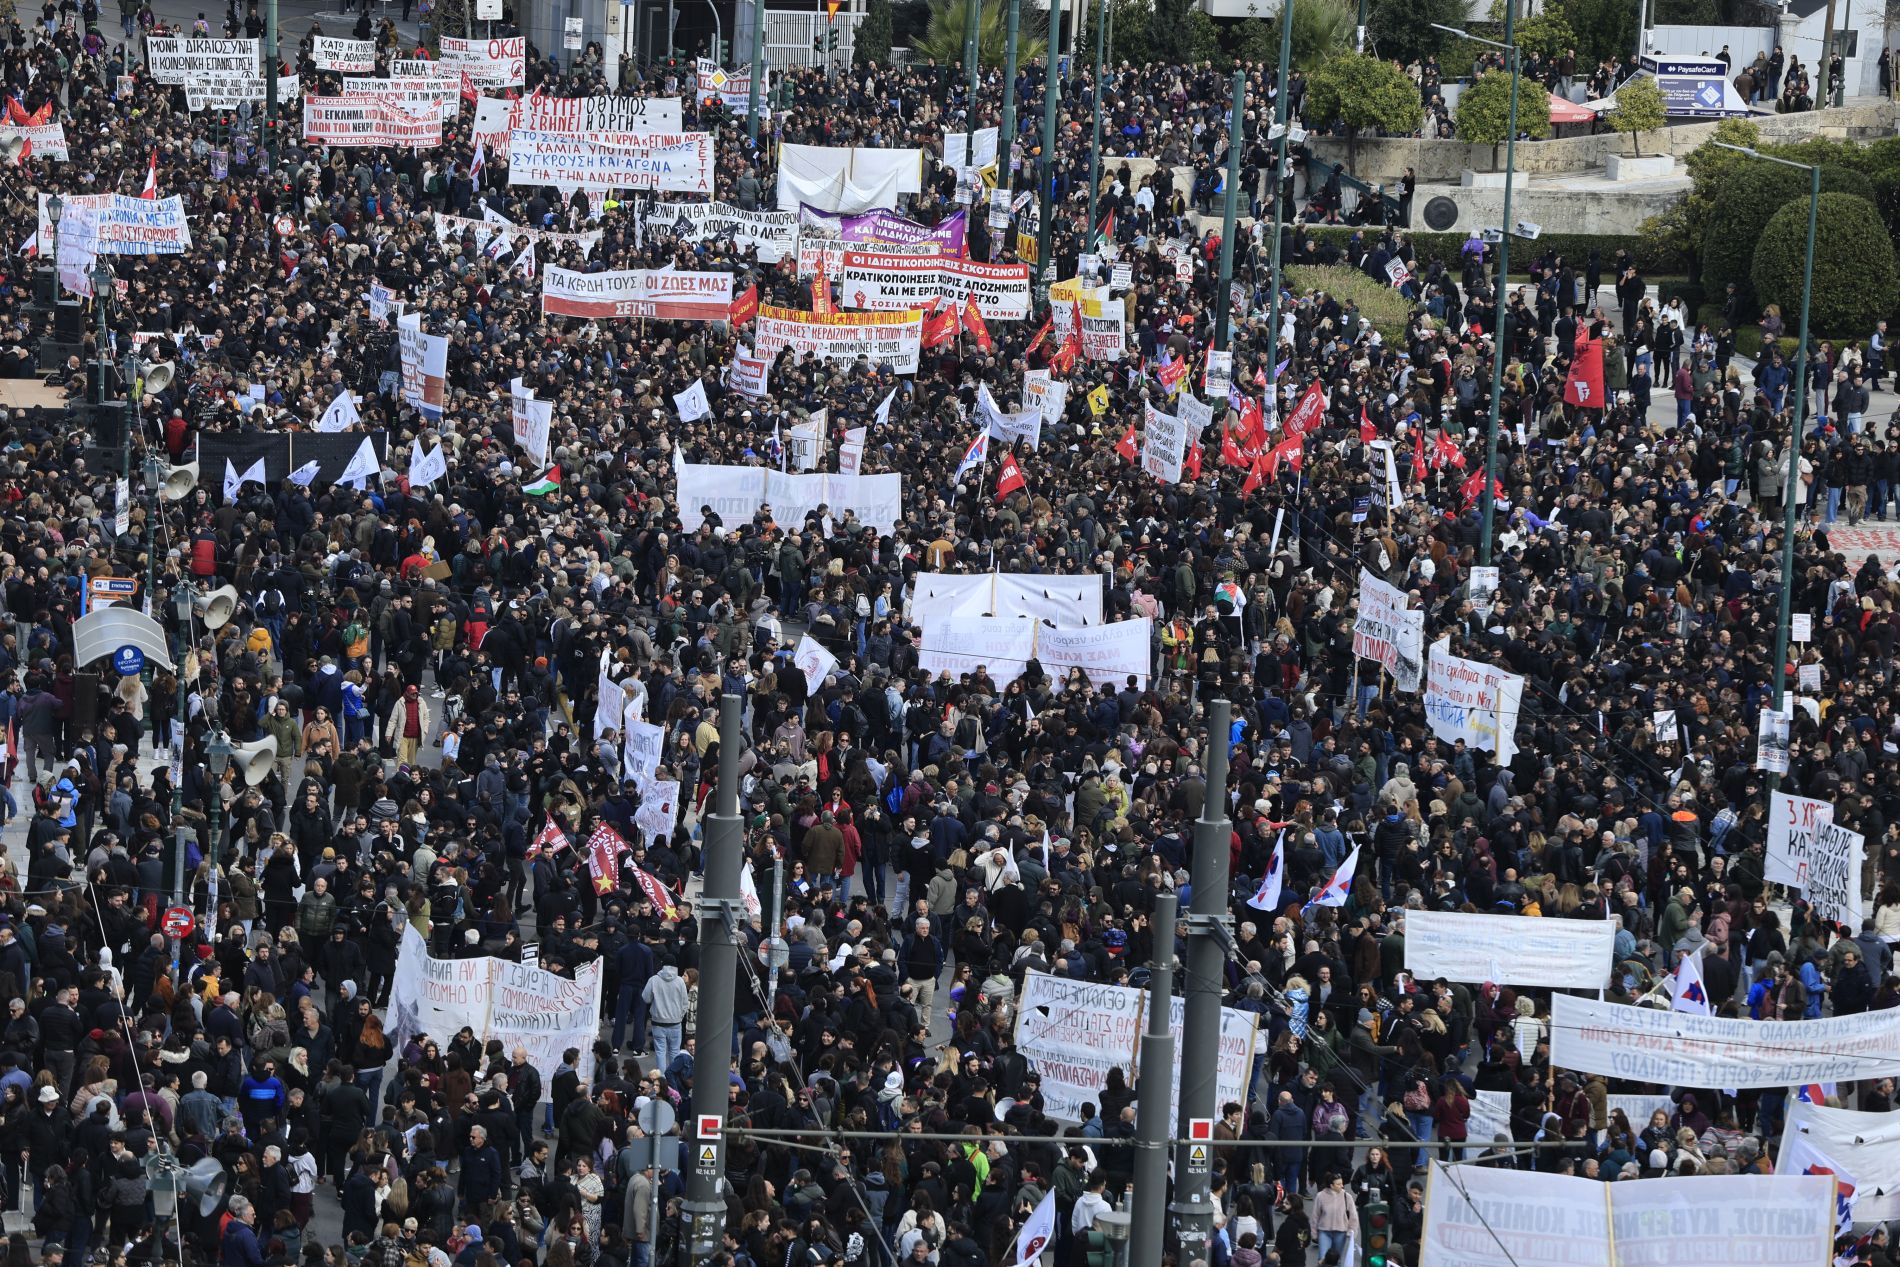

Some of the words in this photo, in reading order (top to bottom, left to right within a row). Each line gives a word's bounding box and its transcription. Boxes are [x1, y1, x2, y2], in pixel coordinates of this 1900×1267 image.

[150, 40, 178, 54] ΜΟΝΗ
[186, 40, 252, 54] ΔΙΚΑΙΟΣΥΝΗ
[320, 40, 344, 52] ΚΑΤΩ
[488, 39, 524, 59] ΟΚΔΕ
[324, 50, 340, 61] ΤΩΝ
[151, 58, 156, 69] Η
[160, 58, 204, 71] ΚΟΙΝΩΝΙΚΗ
[206, 57, 253, 71] ΕΠΑΝΑΣΤΑΣΗ
[1677, 65, 1717, 74] PaysafeCard
[346, 82, 359, 91] ΣΤΟ
[361, 82, 388, 91] ΣΥΣΤΗΜΑ
[390, 82, 401, 90] ΤΟΥ
[529, 95, 583, 116] ΦΕΥΓΕΙ
[313, 109, 323, 120] ΤΟ
[325, 109, 364, 121] ΕΓΚΛΗΜΑ
[308, 122, 331, 132] ΟΛΩΝ
[333, 122, 350, 133] ΤΩΝ
[375, 122, 387, 133] ΘΑ
[530, 114, 581, 132] ΣΒΗΝΕΙ
[599, 115, 634, 132] ΟΡΓΗ
[324, 137, 366, 146] ΥΝΔΙΚΑΤΟ
[512, 131, 536, 142] ΣΤΟ
[536, 142, 582, 155] ΚΑΜΙΑ
[512, 153, 594, 168] ΣΥΓΚΡΟΥΣΗ
[599, 154, 620, 168] ΚΑΙ
[626, 158, 671, 173] ΑΓΩΝΑ
[531, 169, 550, 180] ΓΙΑ
[557, 169, 585, 182] ΤΗΝ
[589, 171, 659, 187] ΑΝΑΤΡΟΠΗ
[115, 195, 121, 207] Η
[162, 198, 177, 211] ΜΑΣ
[110, 210, 139, 223] ΧΡΟΝΙΑ
[145, 213, 176, 227] ΜΕΤΑ
[694, 205, 706, 219] ΘΑ
[855, 226, 873, 235] ΚΑΙ
[109, 240, 149, 254] ΣΥΛΛΟΓΟΙ
[154, 242, 181, 255] ΕΚΠΑ
[852, 255, 865, 264] ΟΙ
[867, 256, 960, 270] ΙΔΙΩΤΙΚΟΠΟΙΗΣΕΙΣ
[961, 264, 1024, 277] ΣΚΟΤΩΝΟΥΝ
[551, 272, 564, 288] ΤΑ
[567, 276, 603, 292] ΚΕΡΔΗ
[605, 275, 637, 291] ΤΟΥΣ
[645, 275, 658, 290] ΟΙ
[660, 276, 696, 291] ΖΩΕΣ
[699, 277, 728, 292] ΜΑΣ
[846, 270, 936, 285] ΚΡΑΤΙΚΟΠΟΙΗΣΕΙΣ
[938, 273, 961, 288] ΧΩΡΙΣ
[963, 276, 1027, 294] ΑΠΟΖΗΜΙΩΣΗ
[880, 286, 899, 296] ΚΑΙ
[902, 286, 915, 296] ΜΕ
[615, 301, 656, 316] ΣΕΤΗΠ
[986, 309, 1020, 318] ΚΟΜΜΑ
[759, 319, 770, 333] ΜΕ
[772, 321, 807, 338] ΑΓΩΝΕΣ
[864, 327, 873, 341] ΤΟ
[1787, 799, 1797, 825] 3
